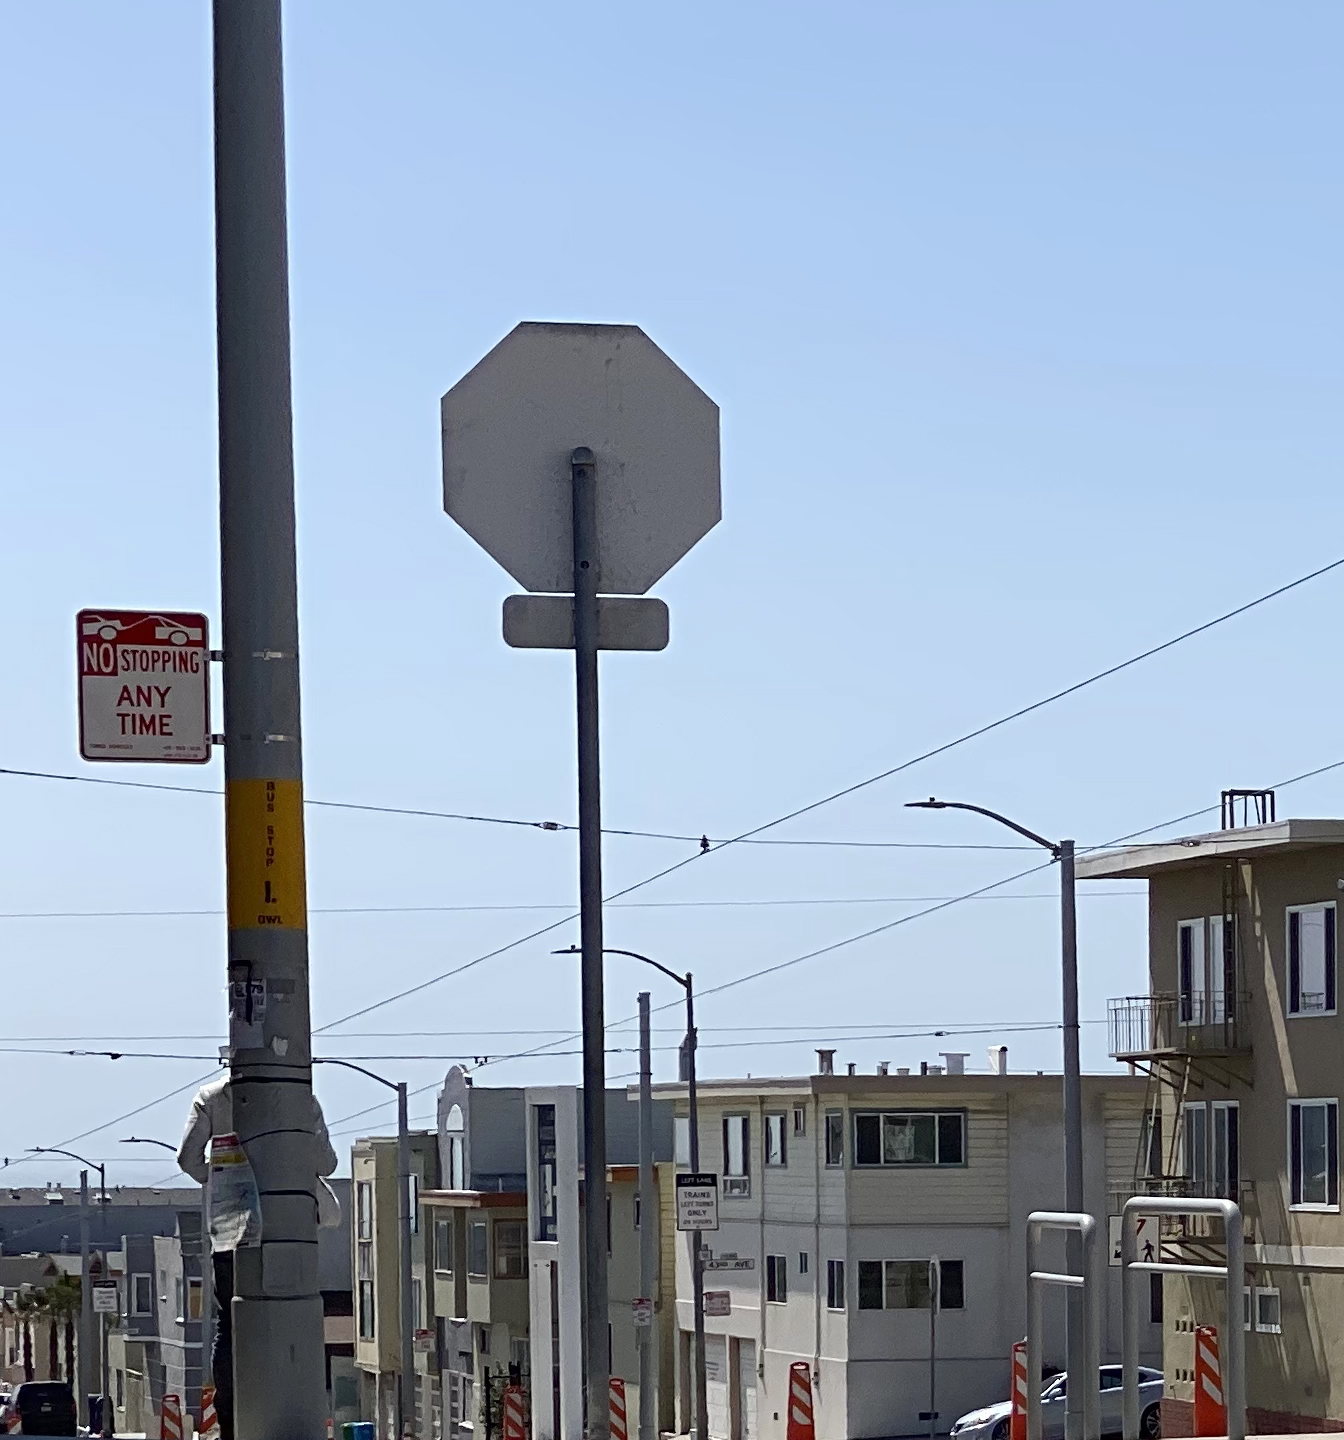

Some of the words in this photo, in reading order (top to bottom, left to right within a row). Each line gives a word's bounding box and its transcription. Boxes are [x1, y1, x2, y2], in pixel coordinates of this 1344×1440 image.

[83, 642, 115, 673] NO
[120, 648, 200, 674] STOPPING
[116, 684, 172, 708] ANY
[116, 712, 173, 736] TIME
[267, 781, 275, 812] BUS
[266, 825, 274, 868] STOP
[258, 914, 283, 925] OWL
